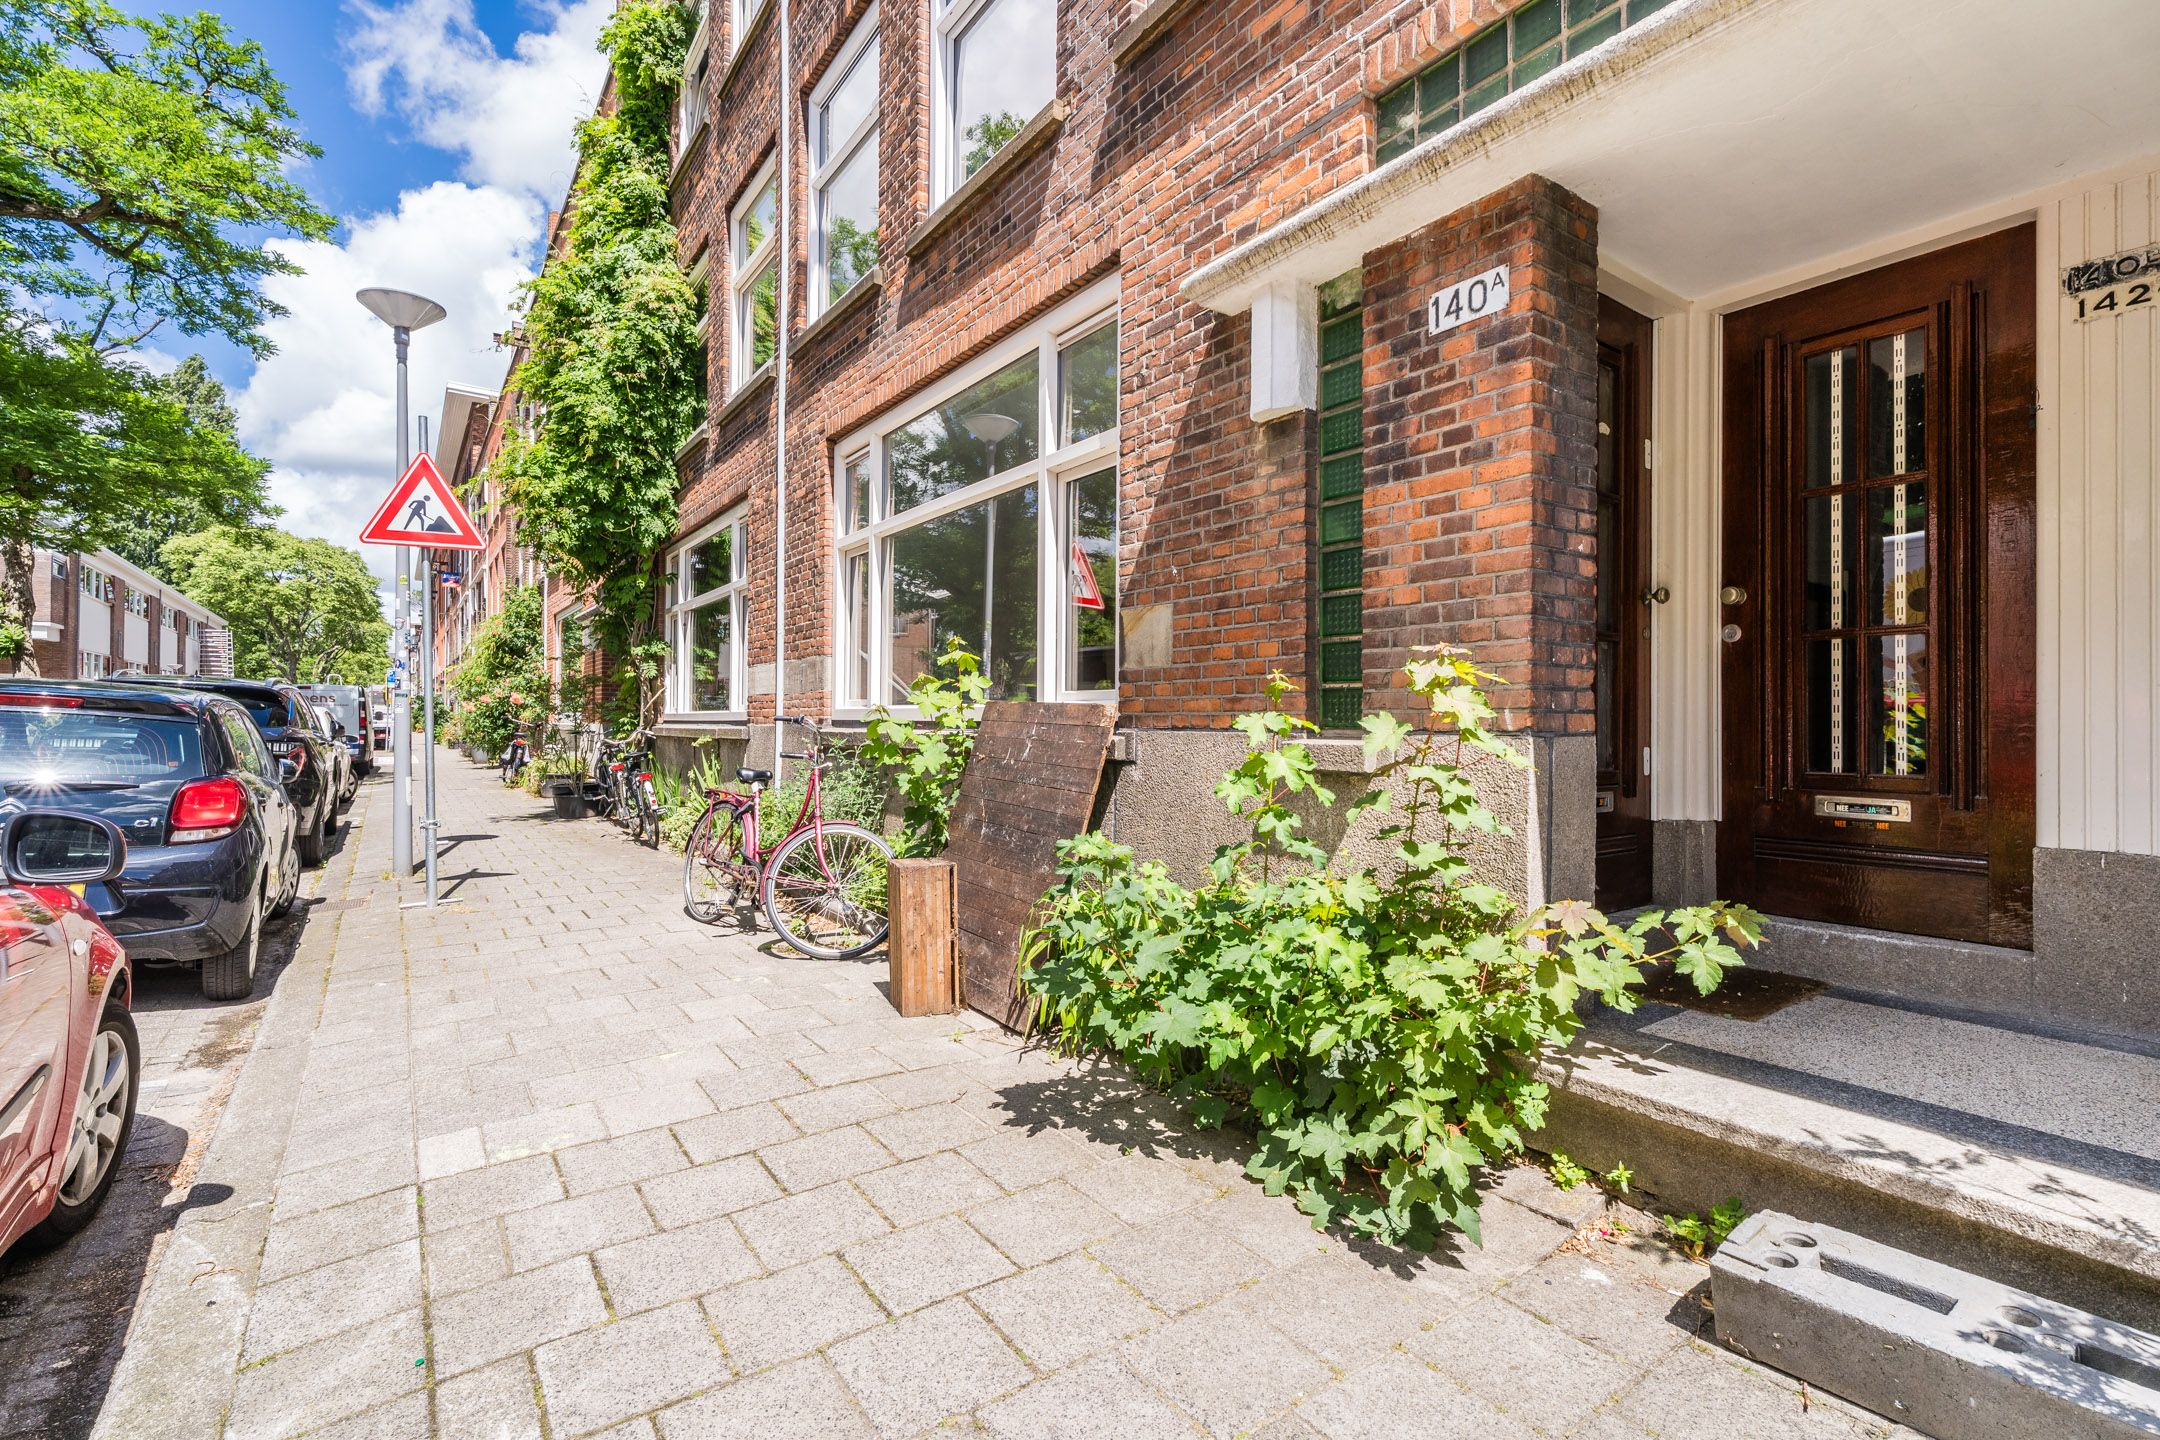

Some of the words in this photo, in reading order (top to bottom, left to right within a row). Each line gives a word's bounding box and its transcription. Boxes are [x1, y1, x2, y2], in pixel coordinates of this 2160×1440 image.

[2079, 284, 2160, 318] 142
[1836, 804, 1849, 812] NEE
[1867, 806, 1877, 814] JA
[1876, 822, 1889, 830] NEE
